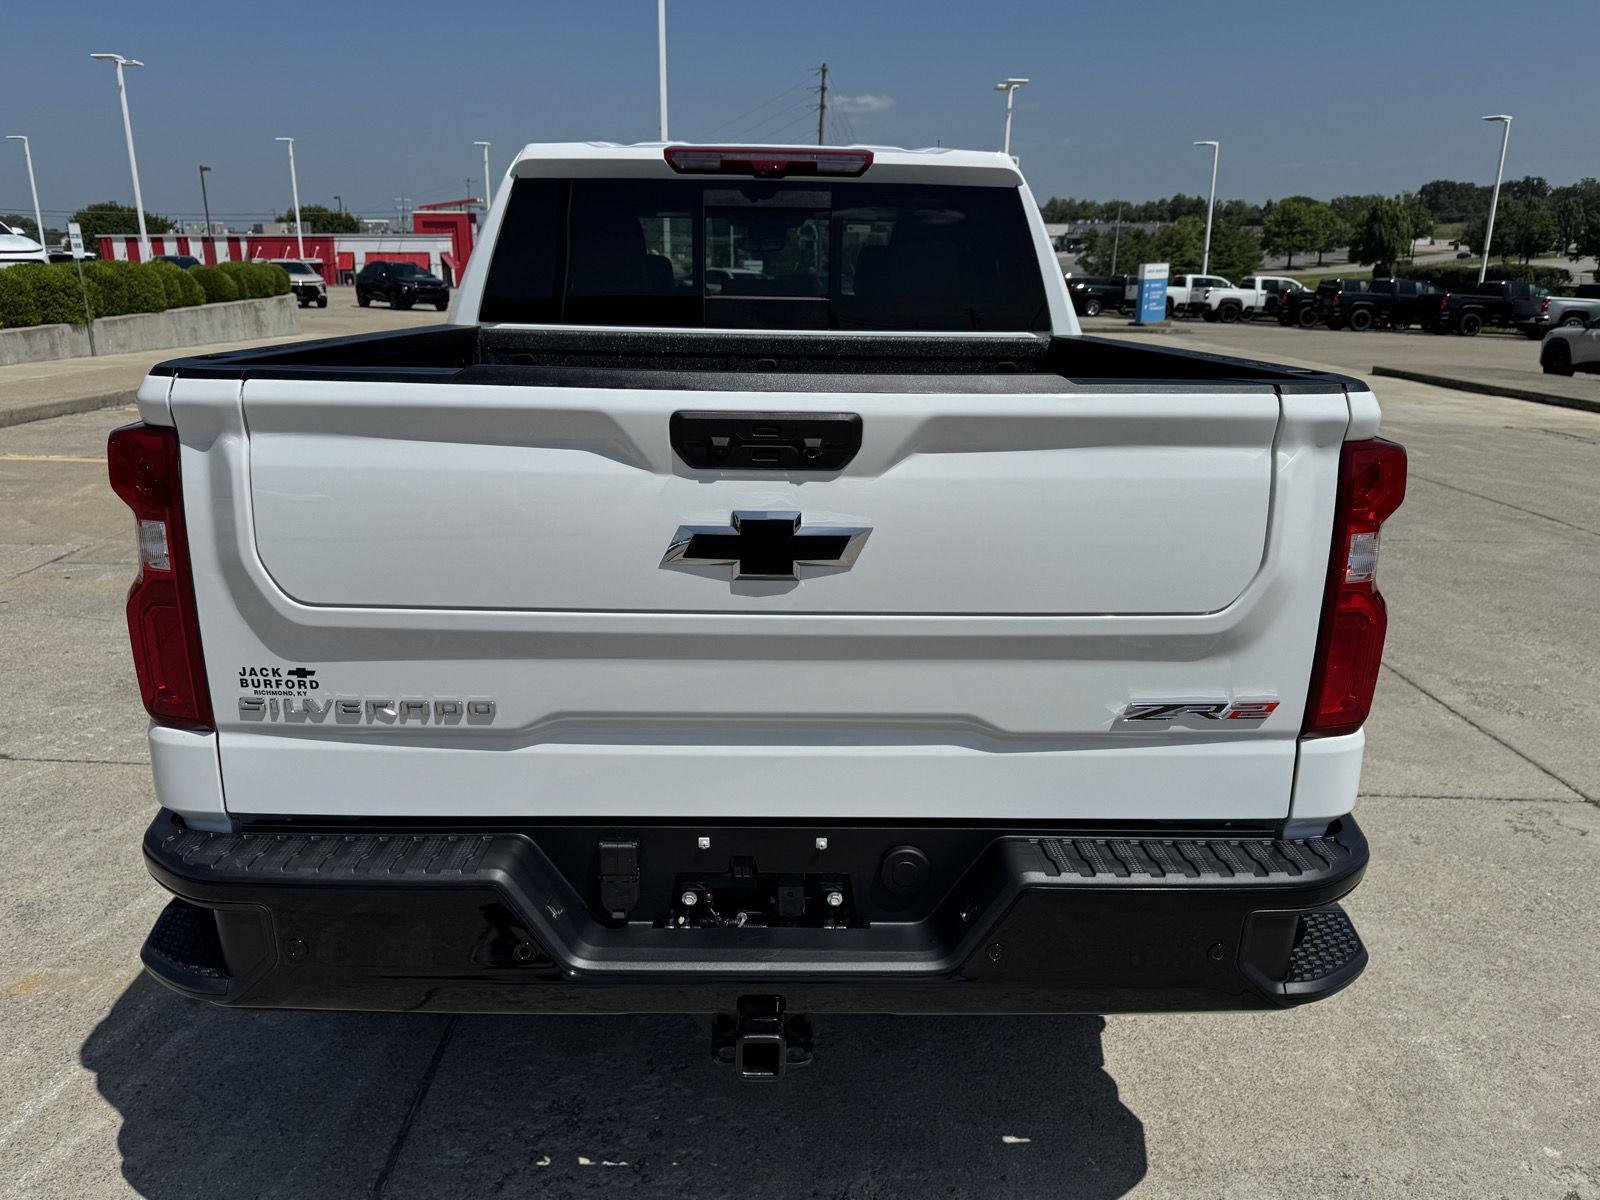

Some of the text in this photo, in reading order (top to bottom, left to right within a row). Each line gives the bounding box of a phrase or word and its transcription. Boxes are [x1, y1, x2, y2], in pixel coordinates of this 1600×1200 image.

[239, 667, 282, 678] JACK
[239, 678, 320, 690] BURFORD
[238, 697, 496, 722] SILVERADO
[1122, 701, 1281, 722] ZR2
